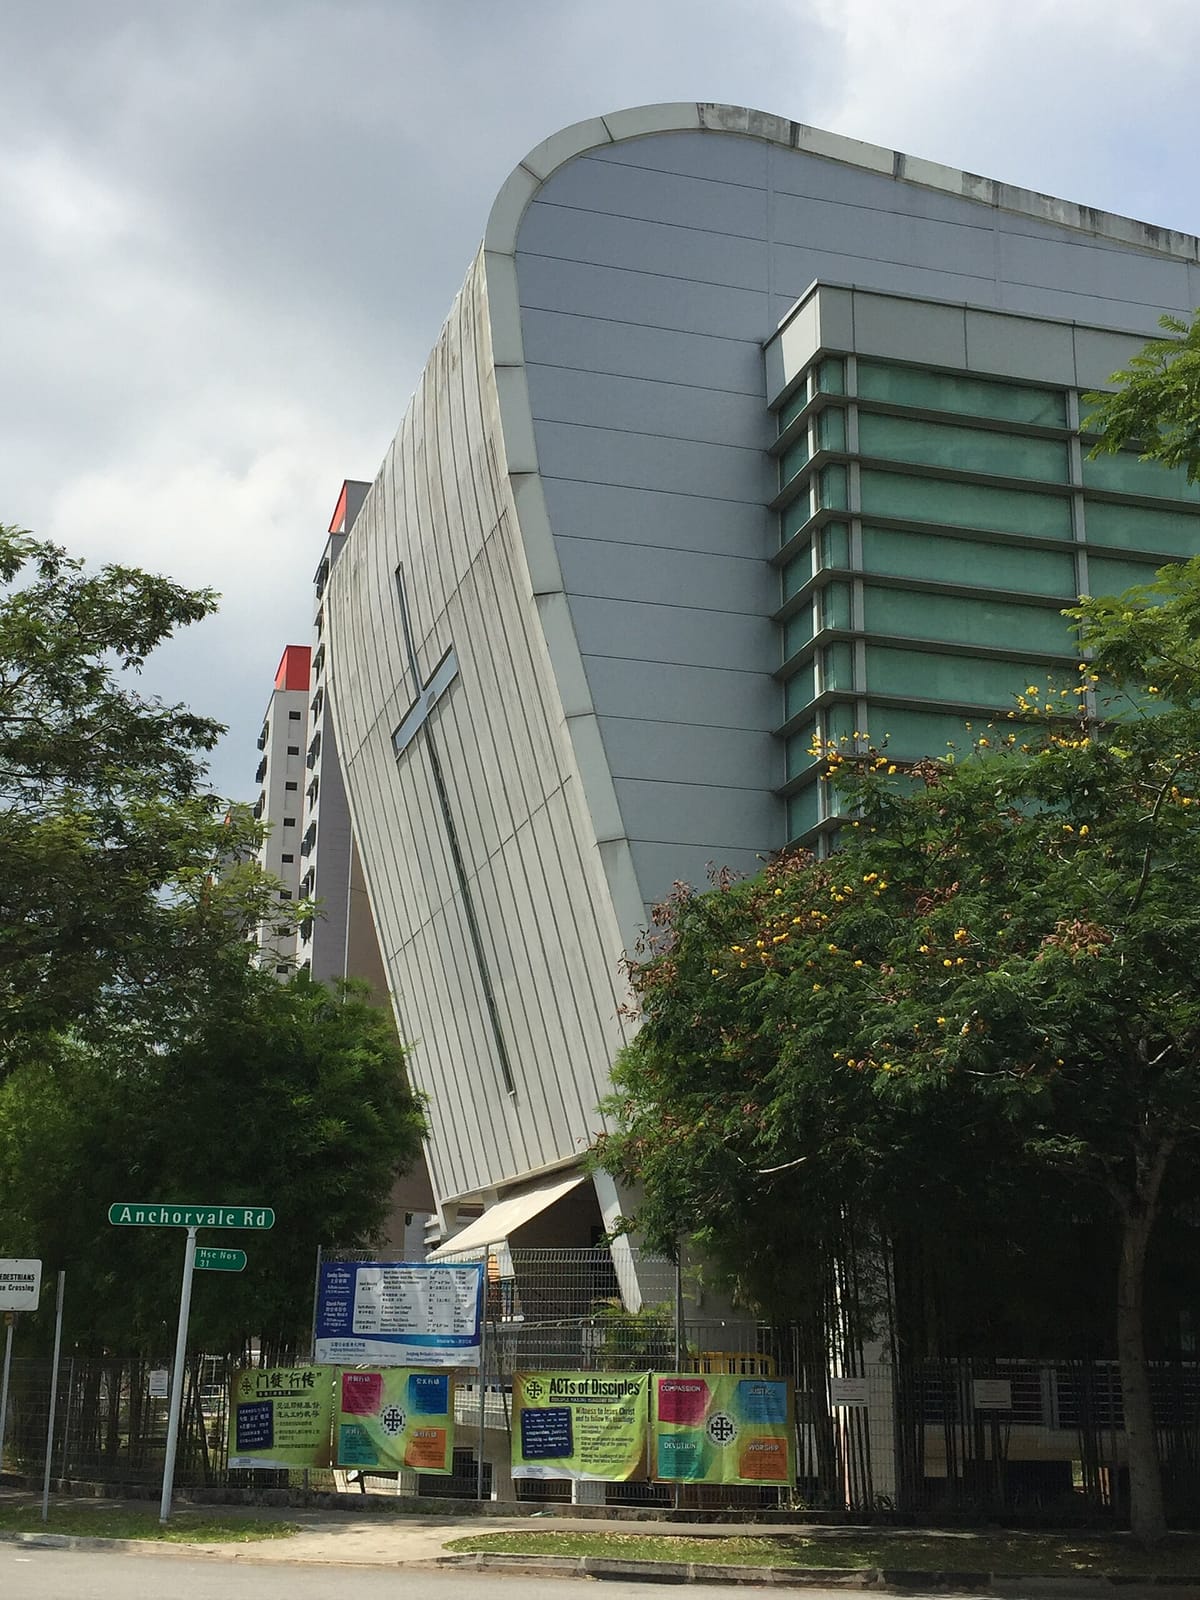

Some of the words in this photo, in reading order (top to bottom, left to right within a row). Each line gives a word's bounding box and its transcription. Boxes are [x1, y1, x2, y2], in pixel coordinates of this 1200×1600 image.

[119, 1207, 235, 1226] Anchorvale
[243, 1210, 266, 1227] Rd
[200, 1250, 217, 1259] Hse
[220, 1251, 237, 1260] Nos
[200, 1259, 210, 1268] 31
[549, 1378, 576, 1395] ACTs
[578, 1379, 590, 1395] of
[591, 1378, 640, 1399] Disciples
